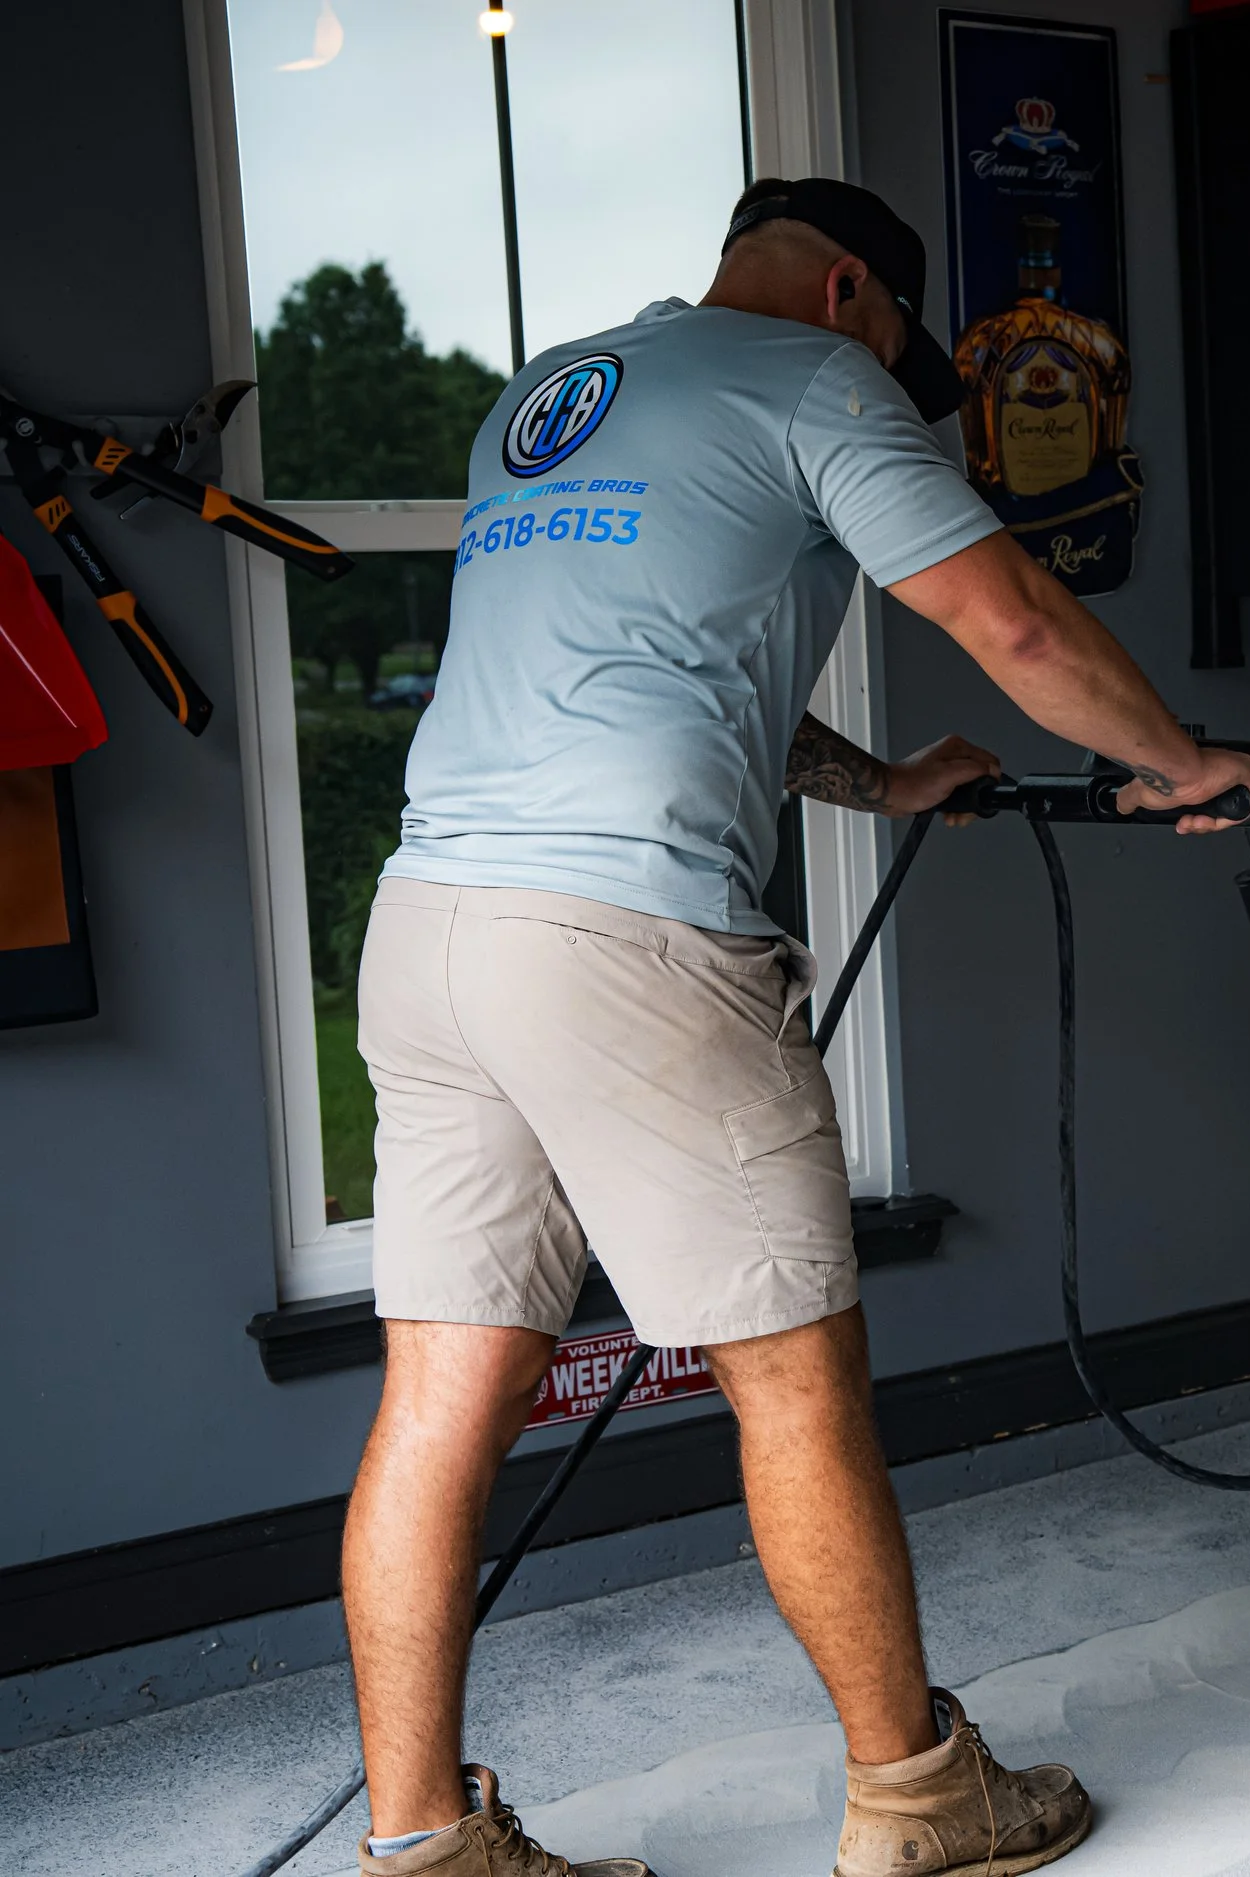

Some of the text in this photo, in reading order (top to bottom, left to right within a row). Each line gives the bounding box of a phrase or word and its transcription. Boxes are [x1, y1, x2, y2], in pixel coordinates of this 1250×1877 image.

[968, 150, 1104, 189] Crown Royal
[512, 480, 585, 503] COATING
[587, 479, 649, 495] BROS
[65, 533, 106, 582] FISKARS
[1050, 533, 1107, 575] Royal
[567, 1335, 641, 1358] VOLUNTE
